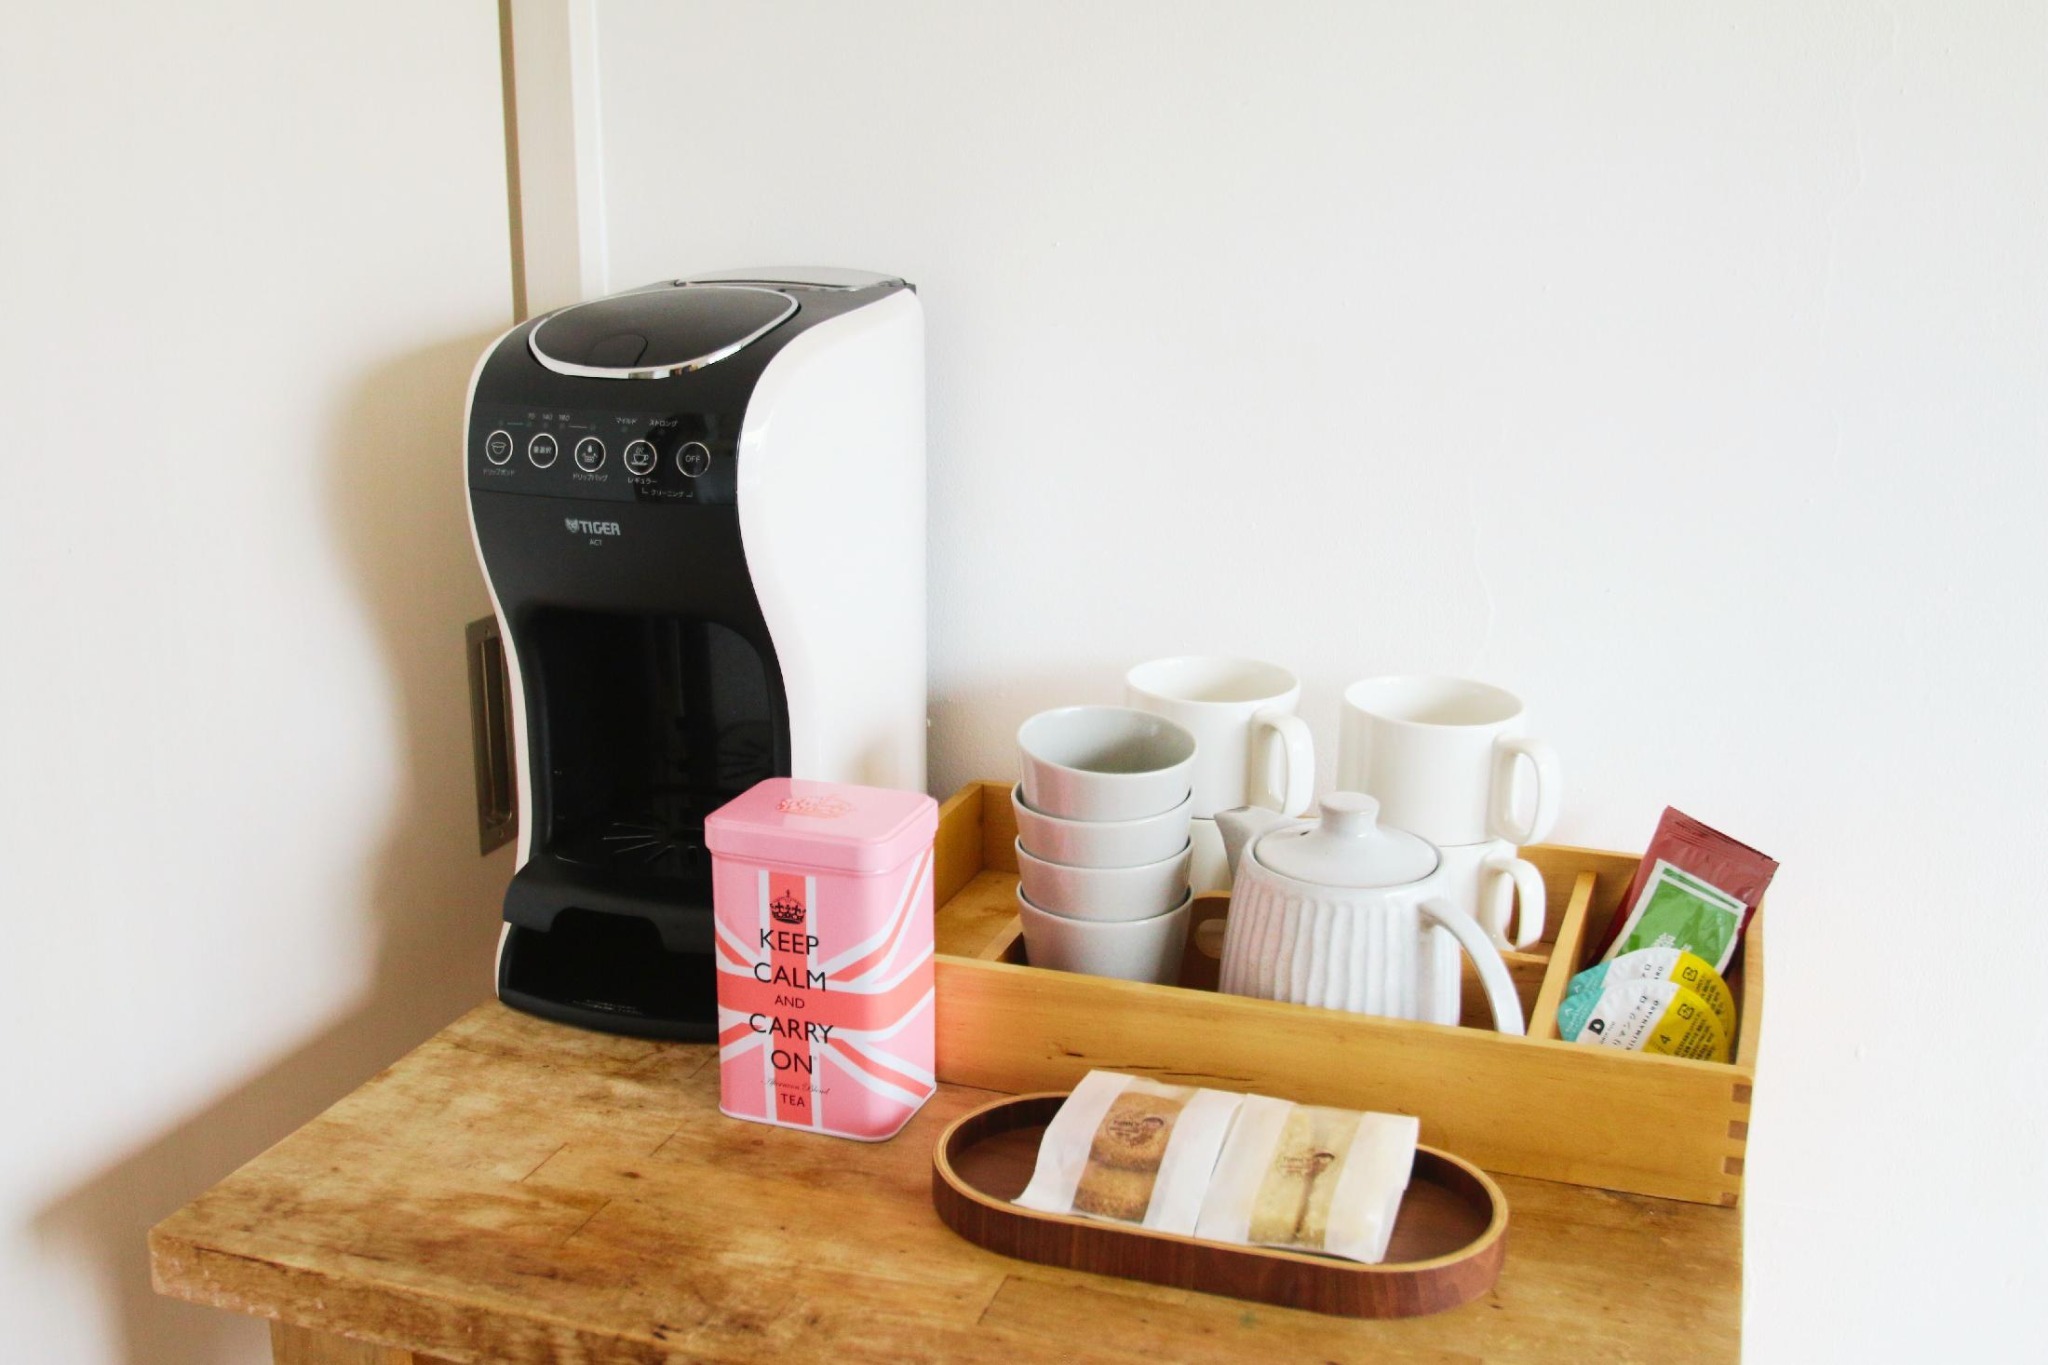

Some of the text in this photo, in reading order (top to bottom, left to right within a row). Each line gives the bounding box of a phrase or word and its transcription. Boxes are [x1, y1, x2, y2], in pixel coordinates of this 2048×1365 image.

[649, 419, 678, 428] ストロング
[685, 455, 701, 463] OFF
[627, 477, 657, 485] レギュラー
[579, 520, 621, 536] TIGER
[760, 928, 819, 955] KEEP
[754, 962, 826, 992] CALM
[774, 994, 806, 1009] AND
[749, 1012, 834, 1044] CARRY
[770, 1049, 813, 1075] ON
[780, 1093, 806, 1108] TEA
